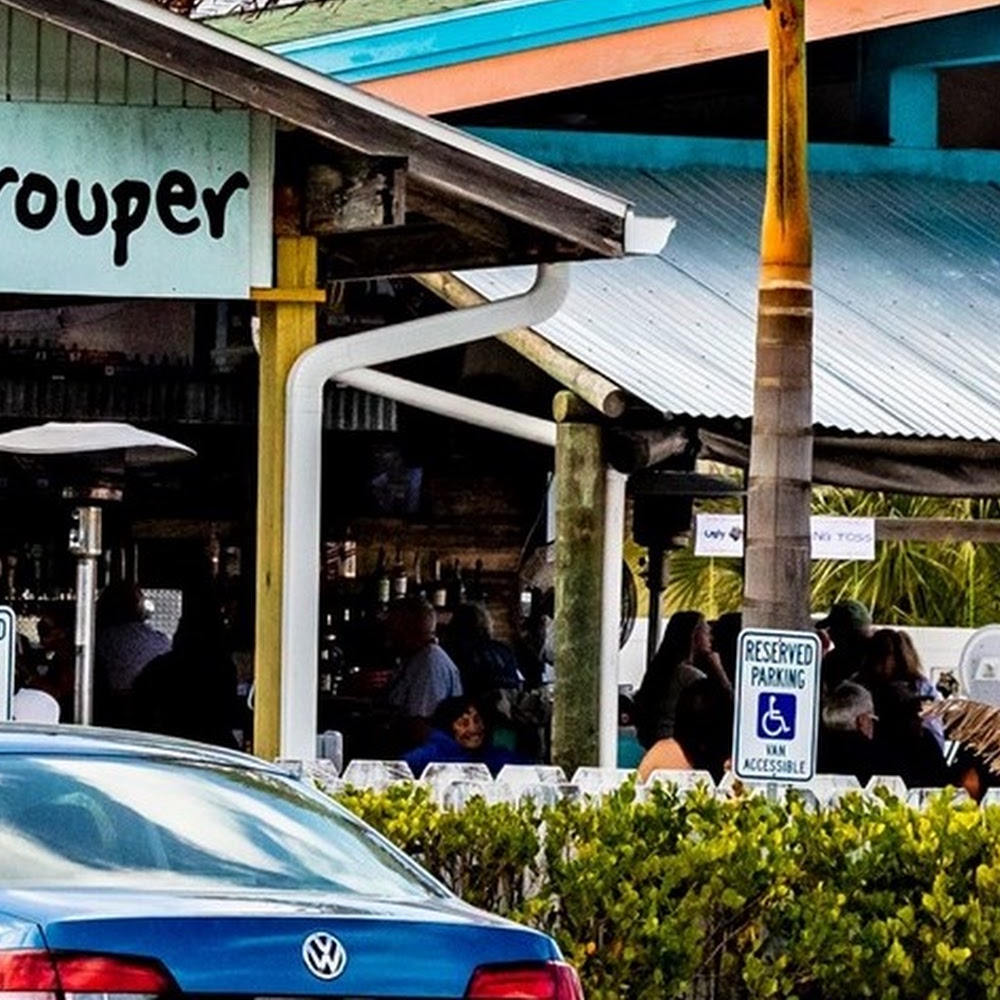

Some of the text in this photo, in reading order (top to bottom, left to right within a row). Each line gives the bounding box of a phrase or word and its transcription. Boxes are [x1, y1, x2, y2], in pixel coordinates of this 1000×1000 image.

[745, 640, 813, 666] RESERVED
[750, 666, 806, 690] PARKING
[765, 744, 787, 757] VAN
[743, 757, 806, 775] ACCESSIBLE
